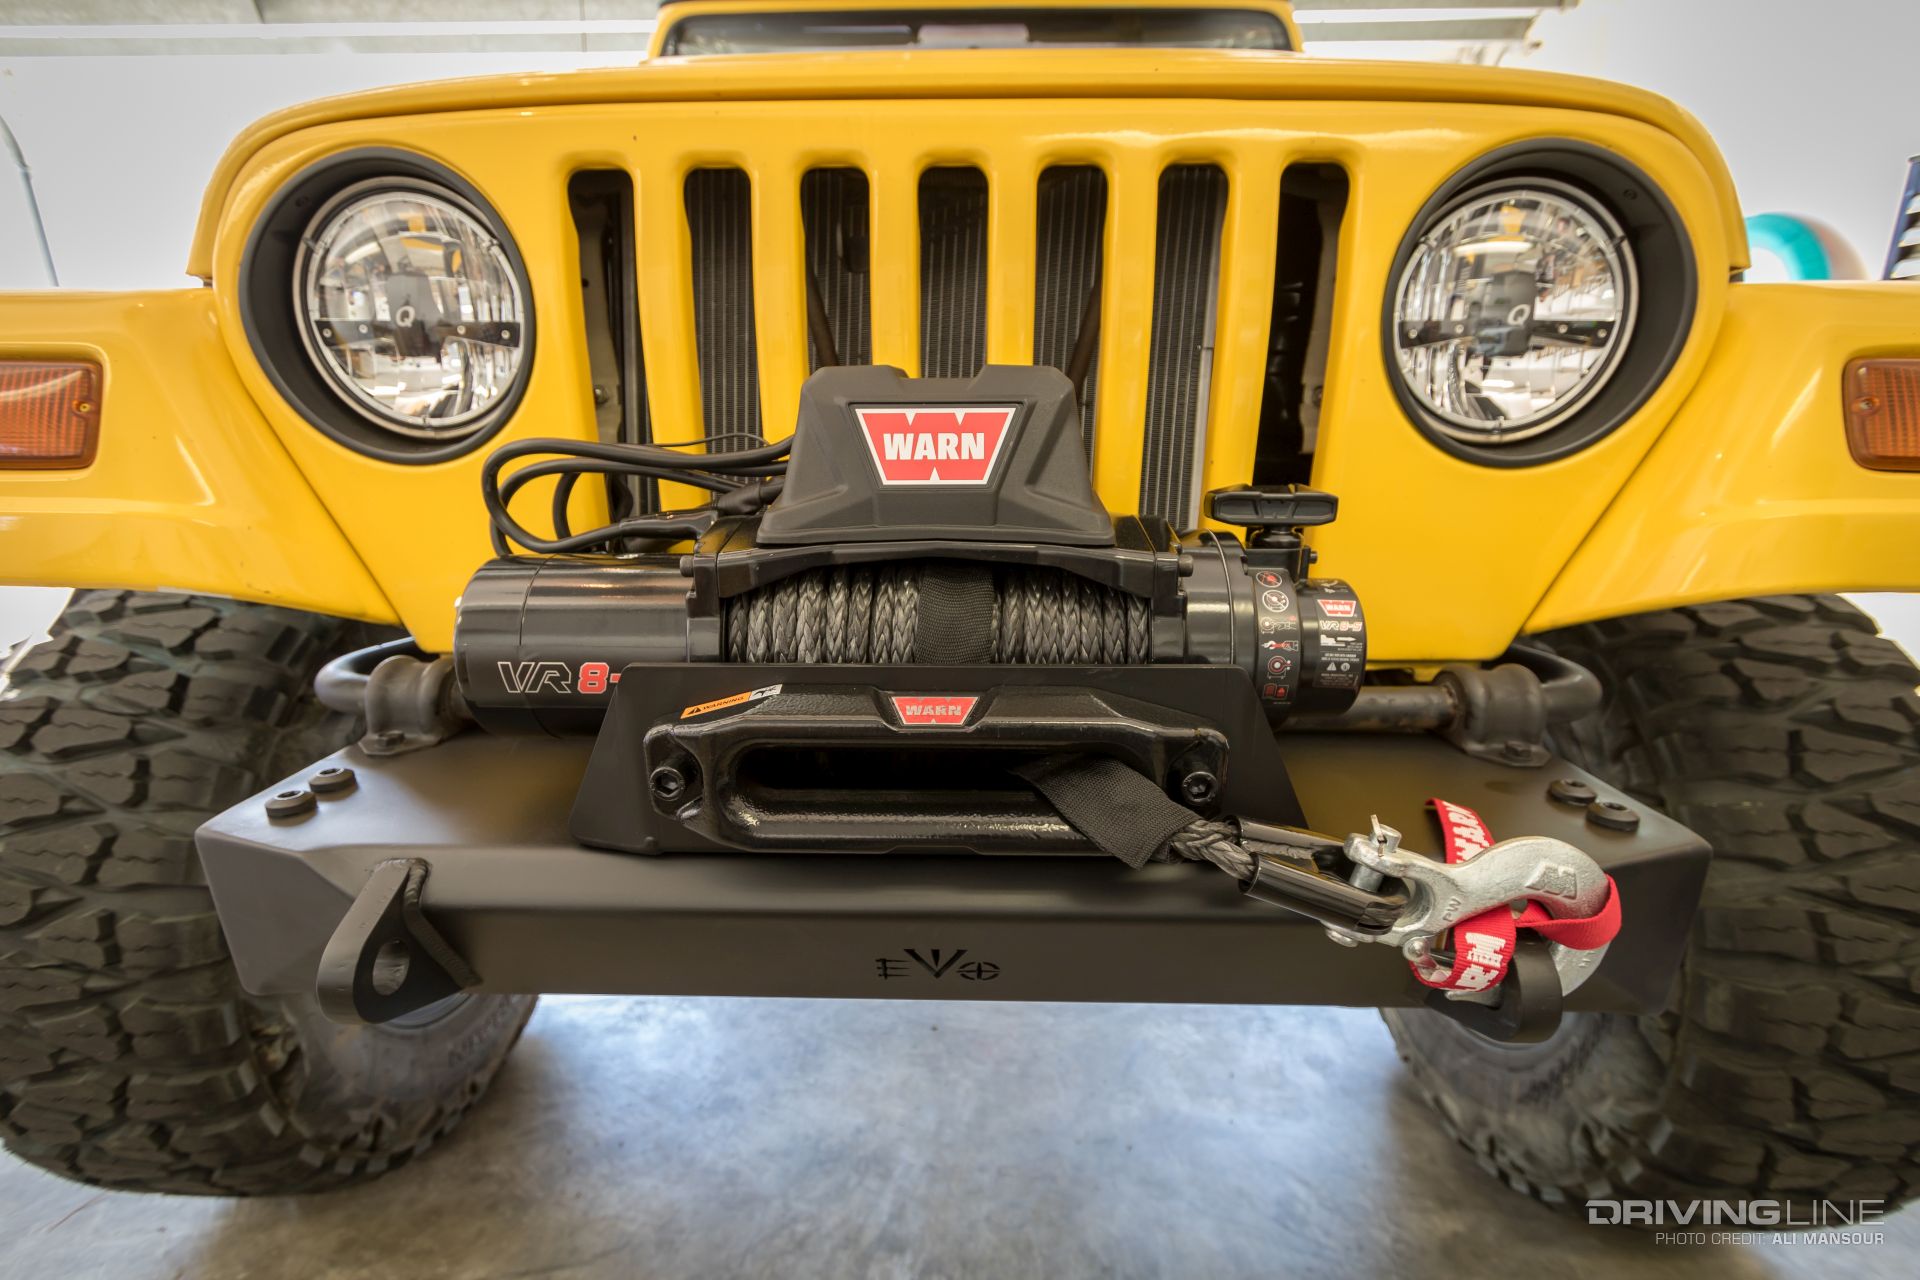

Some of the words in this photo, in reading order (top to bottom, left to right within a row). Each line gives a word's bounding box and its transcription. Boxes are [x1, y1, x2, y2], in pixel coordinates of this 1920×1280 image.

[883, 432, 985, 461] WARN
[497, 661, 572, 694] VR
[905, 704, 962, 717] WARN
